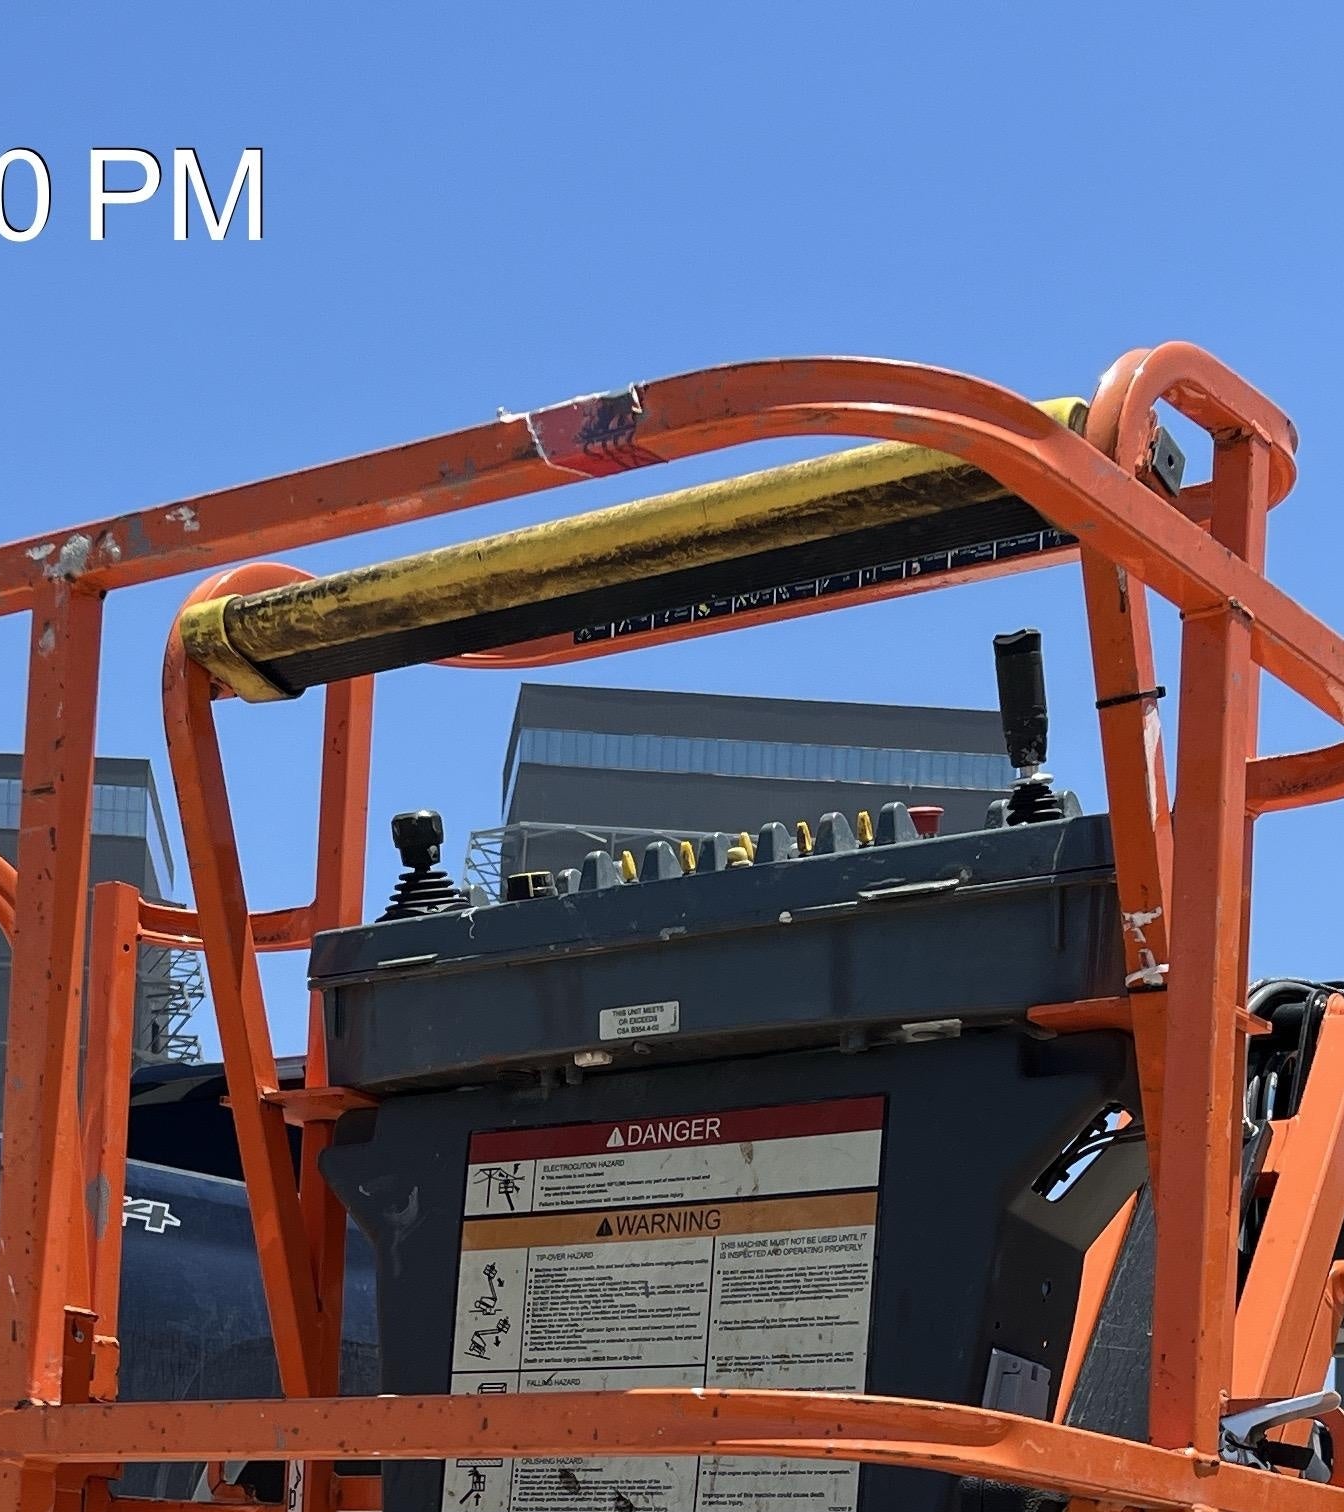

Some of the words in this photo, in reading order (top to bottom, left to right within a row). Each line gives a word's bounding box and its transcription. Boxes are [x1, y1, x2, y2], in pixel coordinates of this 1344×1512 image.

[627, 1118, 721, 1145] DANGER
[598, 1159, 625, 1169] HAZARD
[617, 1209, 720, 1235] WARNING
[737, 1240, 768, 1249] MACHINE
[770, 1238, 789, 1247] MUST
[791, 1237, 805, 1245] NOT
[807, 1236, 816, 1244] BE
[817, 1235, 837, 1243] USED
[838, 1233, 859, 1241] UNTIL
[567, 1252, 593, 1260] HAZARD
[728, 1250, 766, 1259] INSPECTED
[768, 1248, 782, 1257] AND
[783, 1246, 824, 1256] OPERATING
